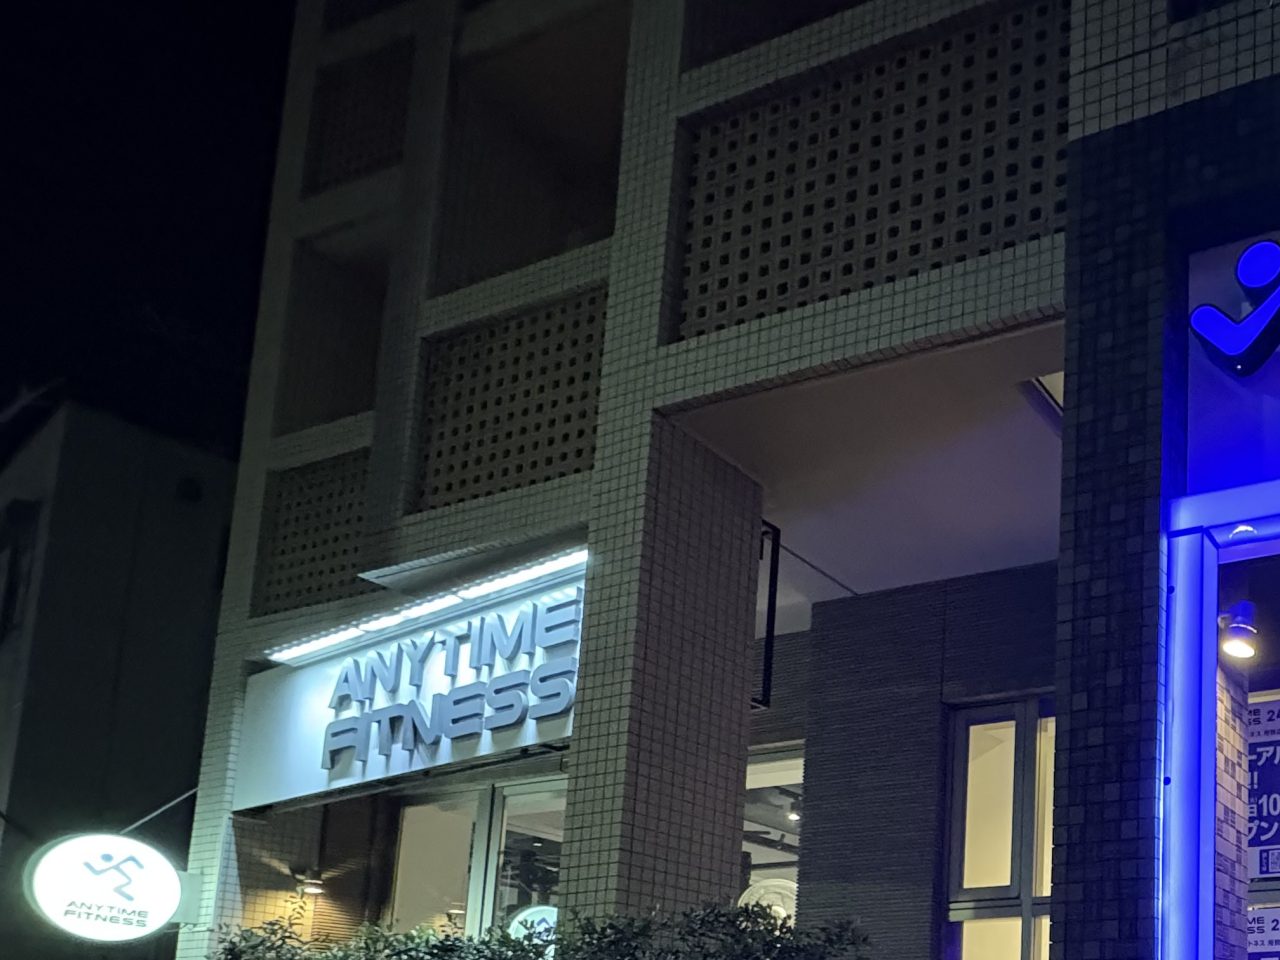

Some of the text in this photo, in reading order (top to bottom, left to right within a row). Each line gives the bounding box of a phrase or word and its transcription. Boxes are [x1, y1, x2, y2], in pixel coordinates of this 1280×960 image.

[328, 586, 583, 710] ANYTIME
[321, 656, 577, 770] FITNESS
[64, 910, 148, 928] FITNESS
[66, 901, 149, 918] ANYTIME
